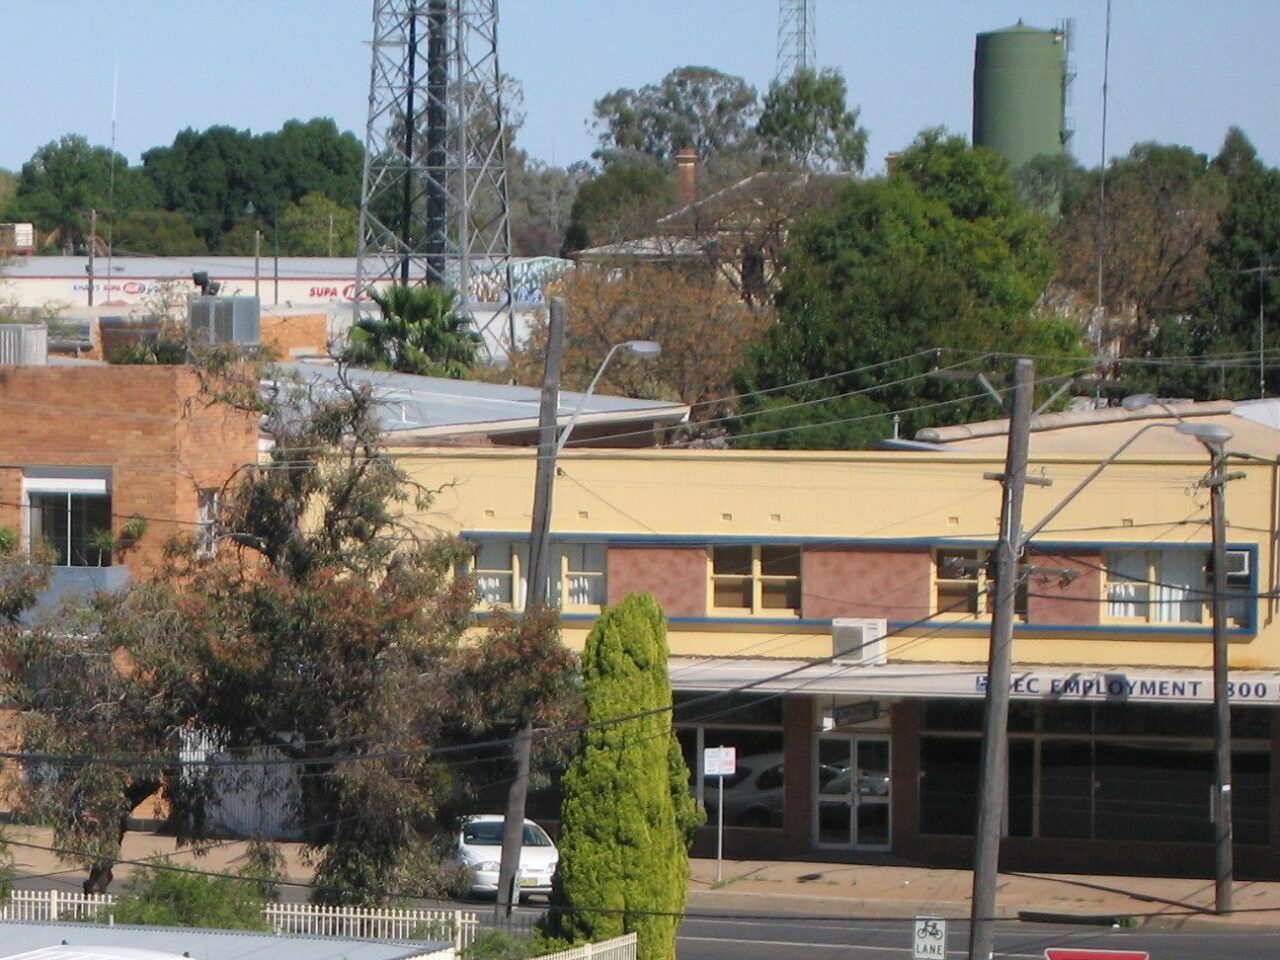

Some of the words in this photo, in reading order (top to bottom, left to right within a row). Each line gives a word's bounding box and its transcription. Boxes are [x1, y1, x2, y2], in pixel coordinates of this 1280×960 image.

[309, 286, 338, 298] SUPA
[1050, 678, 1202, 697] EMPLOYMENT
[916, 943, 943, 956] LANE
